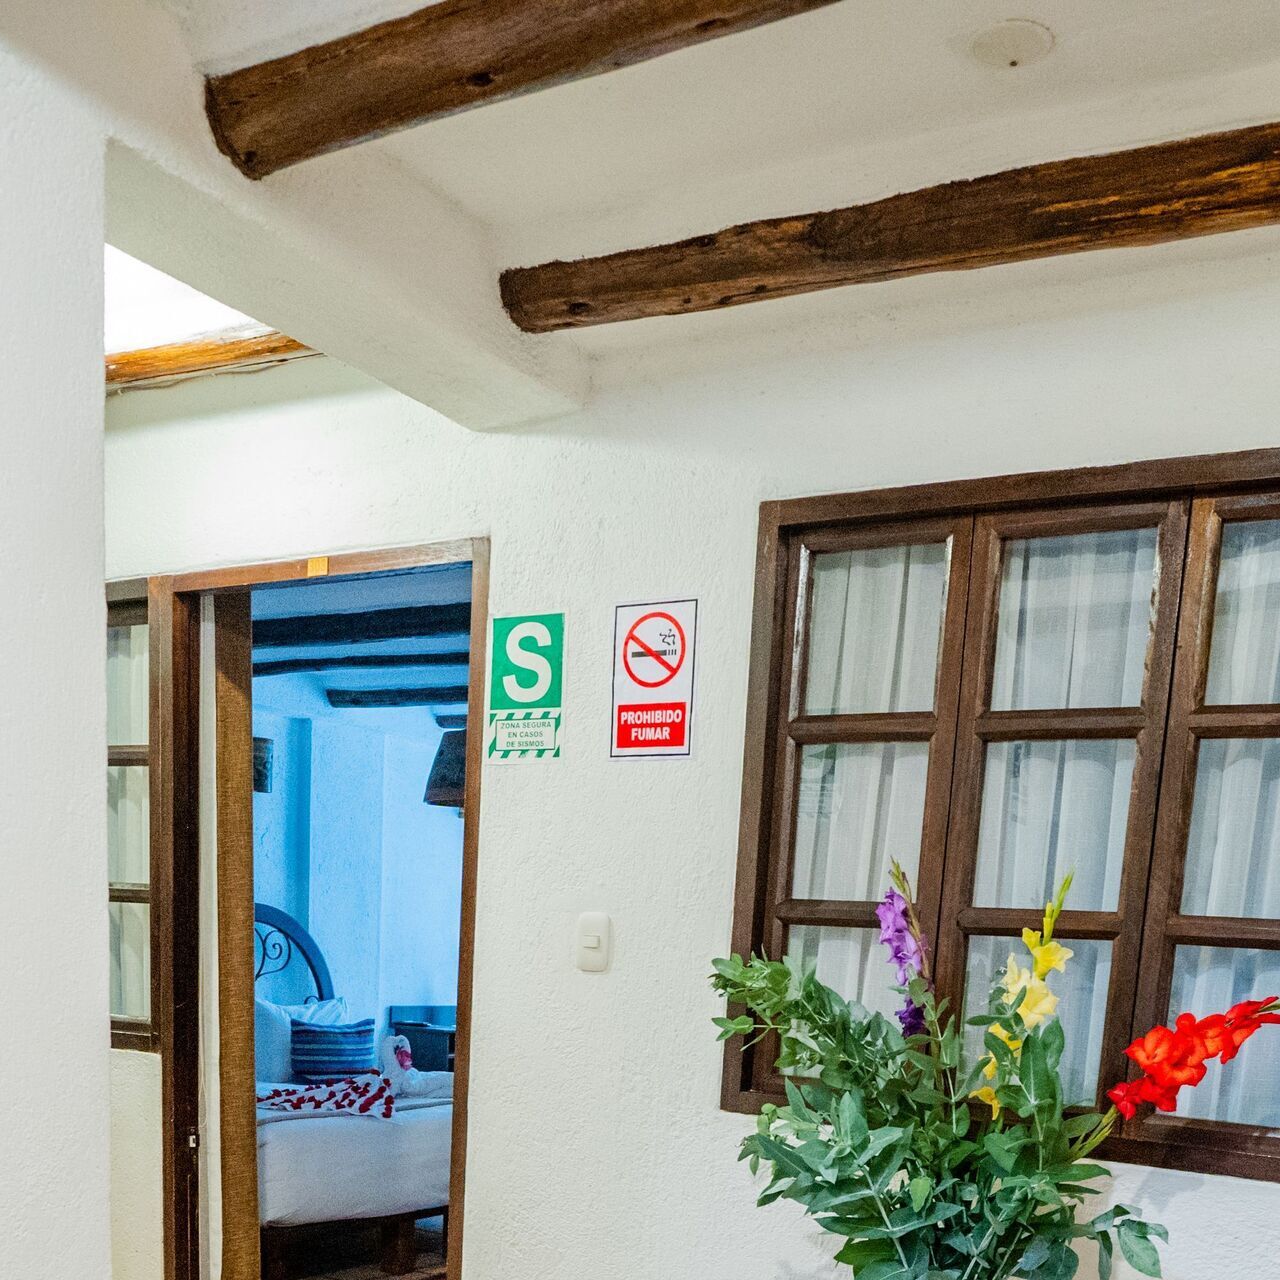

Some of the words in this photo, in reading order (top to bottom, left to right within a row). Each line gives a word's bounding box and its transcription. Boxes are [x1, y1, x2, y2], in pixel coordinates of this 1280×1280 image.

[502, 621, 553, 703] S
[620, 709, 683, 725] PROHIBIDO
[500, 722, 521, 730] ZONA
[522, 721, 552, 729] SEGURA
[519, 730, 544, 738] CASOS
[631, 726, 671, 741] FUMAR
[517, 740, 545, 748] SISMOS
